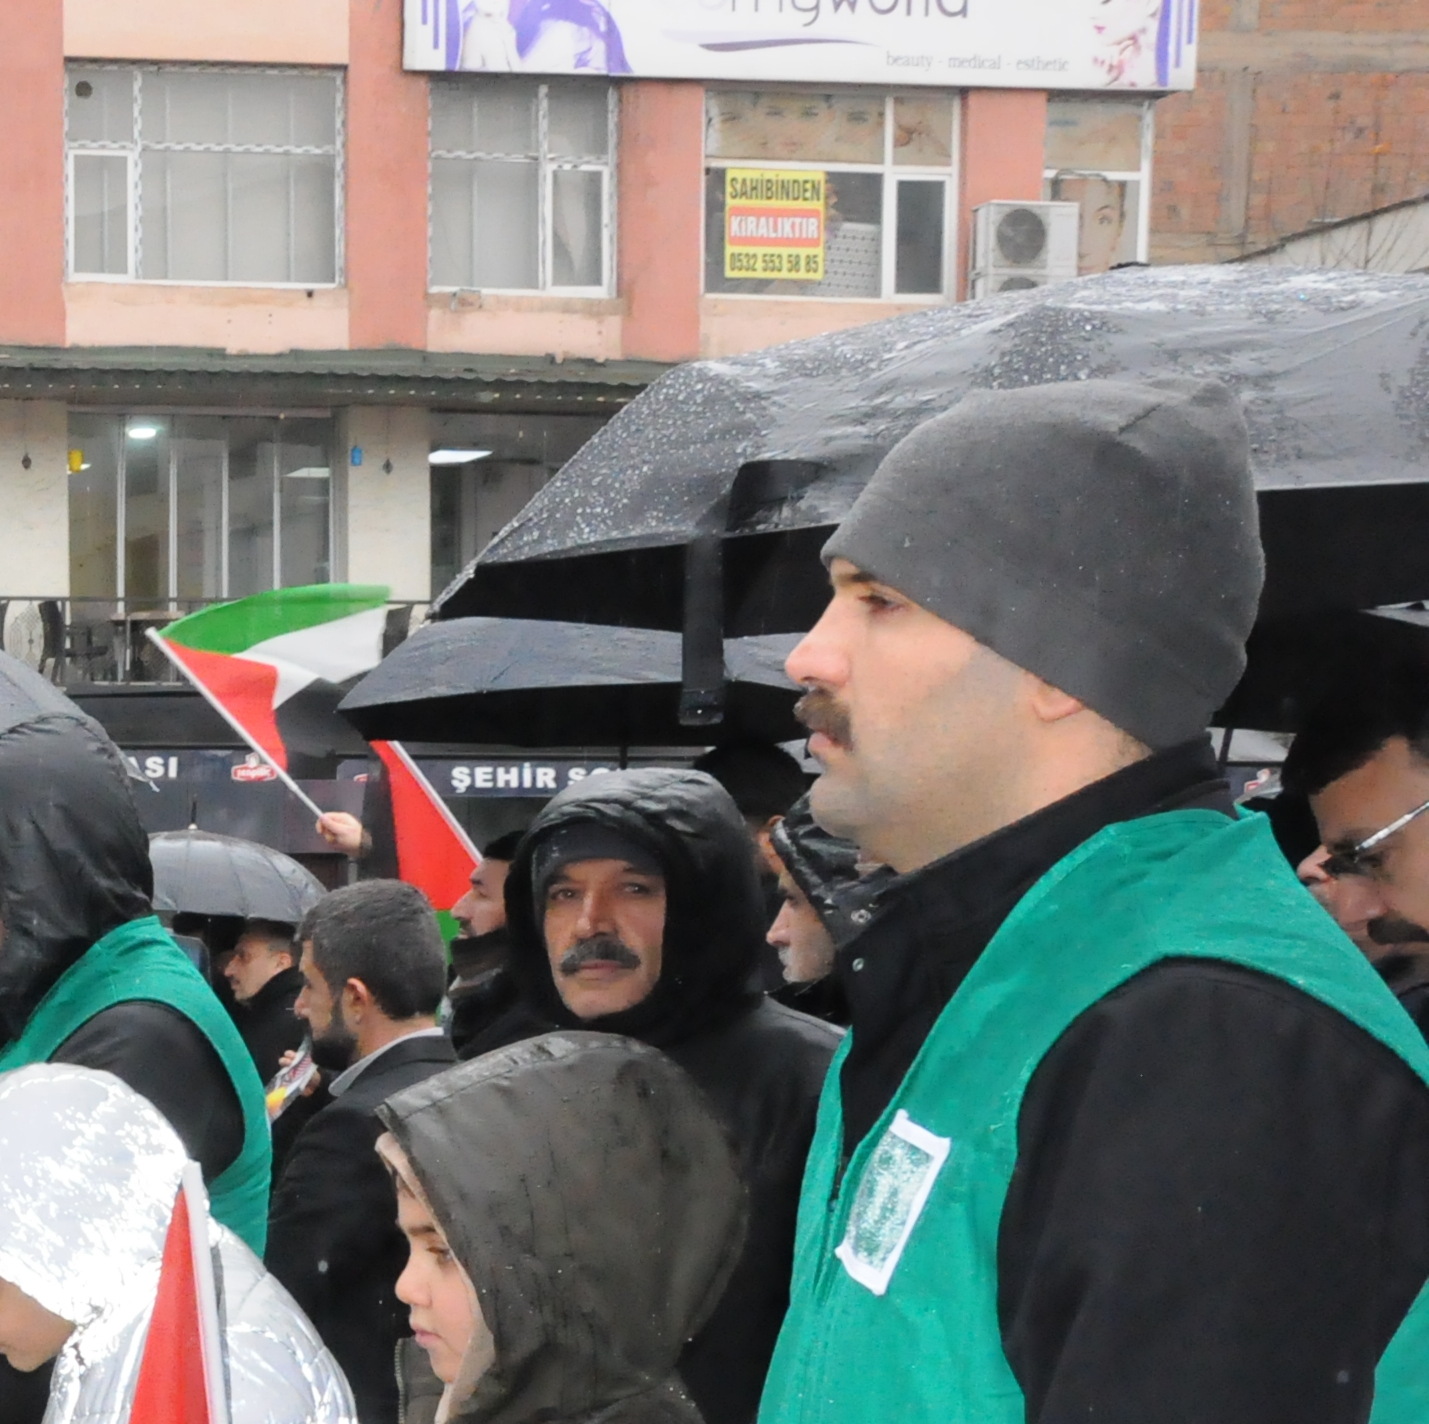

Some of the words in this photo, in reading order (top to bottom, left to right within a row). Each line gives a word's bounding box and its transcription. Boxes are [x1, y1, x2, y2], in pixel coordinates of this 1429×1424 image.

[886, 51, 933, 72] beauty
[947, 54, 1002, 70] medical
[1015, 56, 1069, 72] esthetic
[729, 173, 821, 202] SAHİBİNDEN
[729, 252, 758, 272] 0532
[761, 253, 783, 273] 553
[128, 756, 178, 779] SI
[451, 761, 557, 794] ŞEHİR
